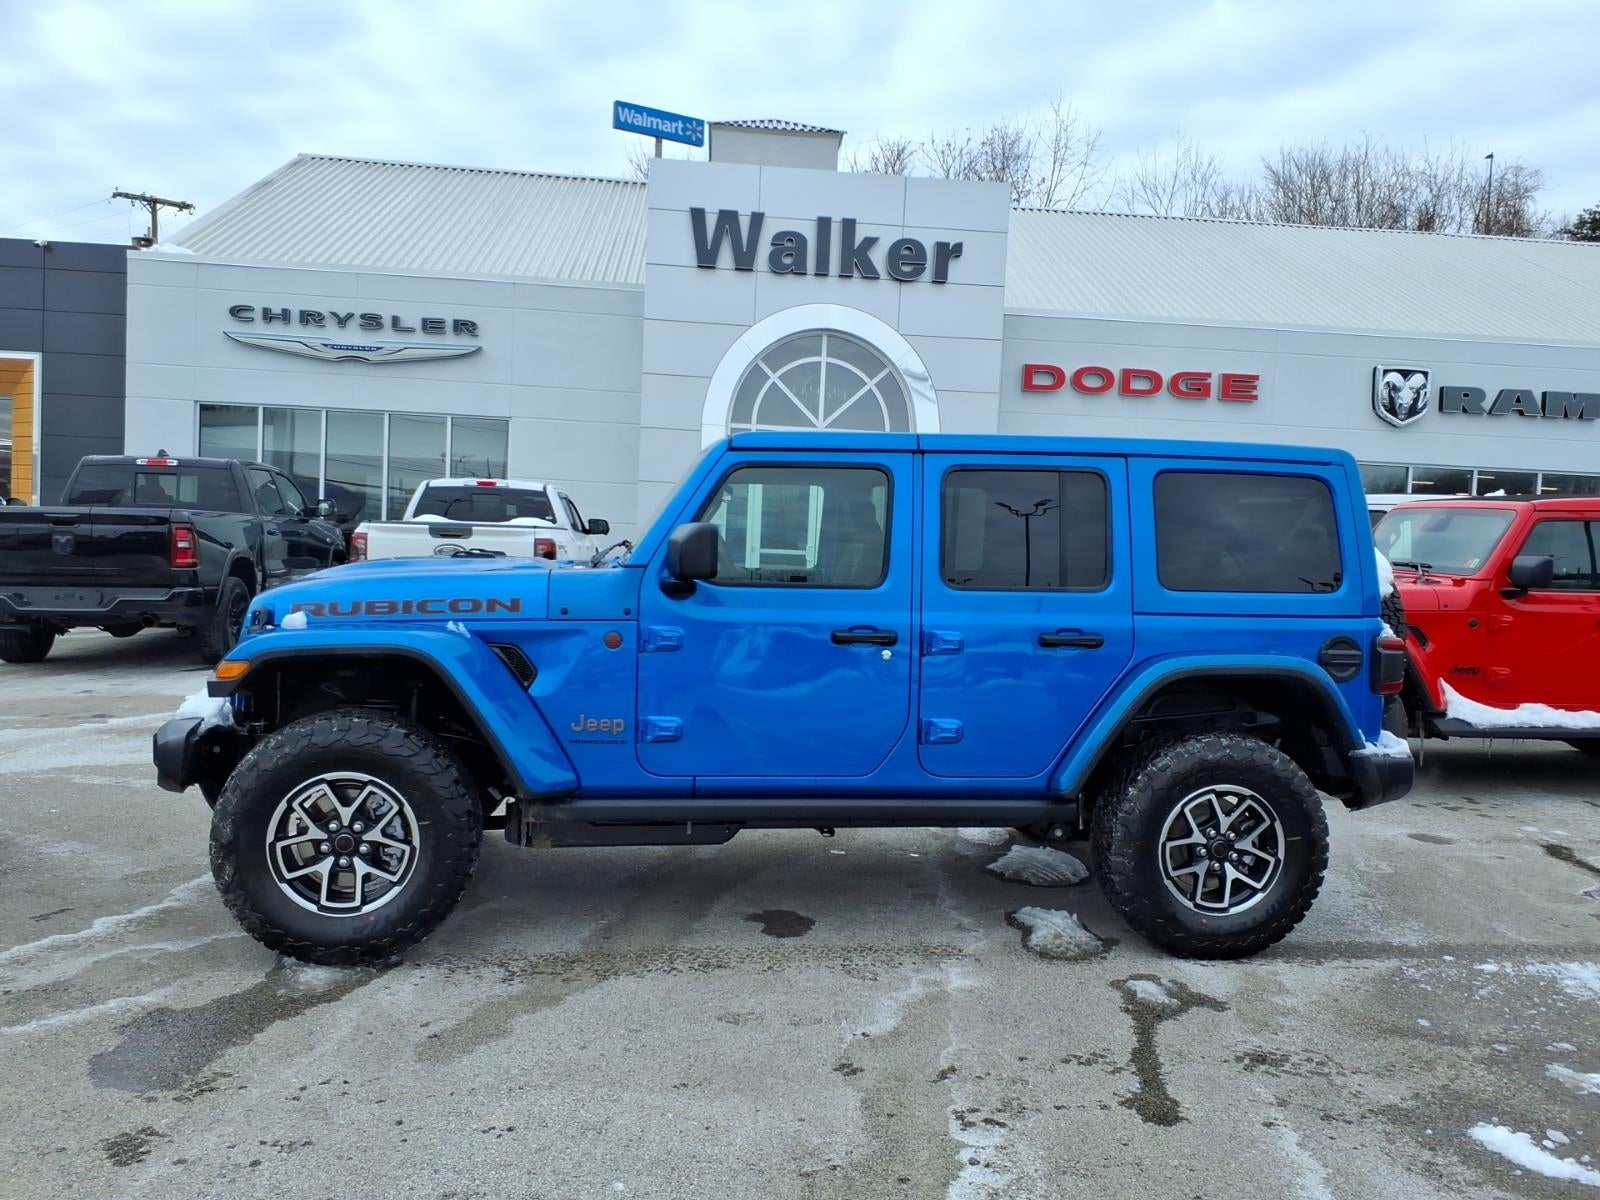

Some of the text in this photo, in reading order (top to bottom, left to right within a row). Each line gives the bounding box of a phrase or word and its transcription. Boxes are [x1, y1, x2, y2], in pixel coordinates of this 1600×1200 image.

[617, 105, 684, 136] Walmart
[689, 207, 963, 282] Walker
[228, 304, 479, 336] CHRYSLER
[1022, 363, 1260, 402] DODGE
[1438, 385, 1600, 419] RAM
[291, 597, 521, 617] RUBICON
[570, 713, 625, 735] Jeep
